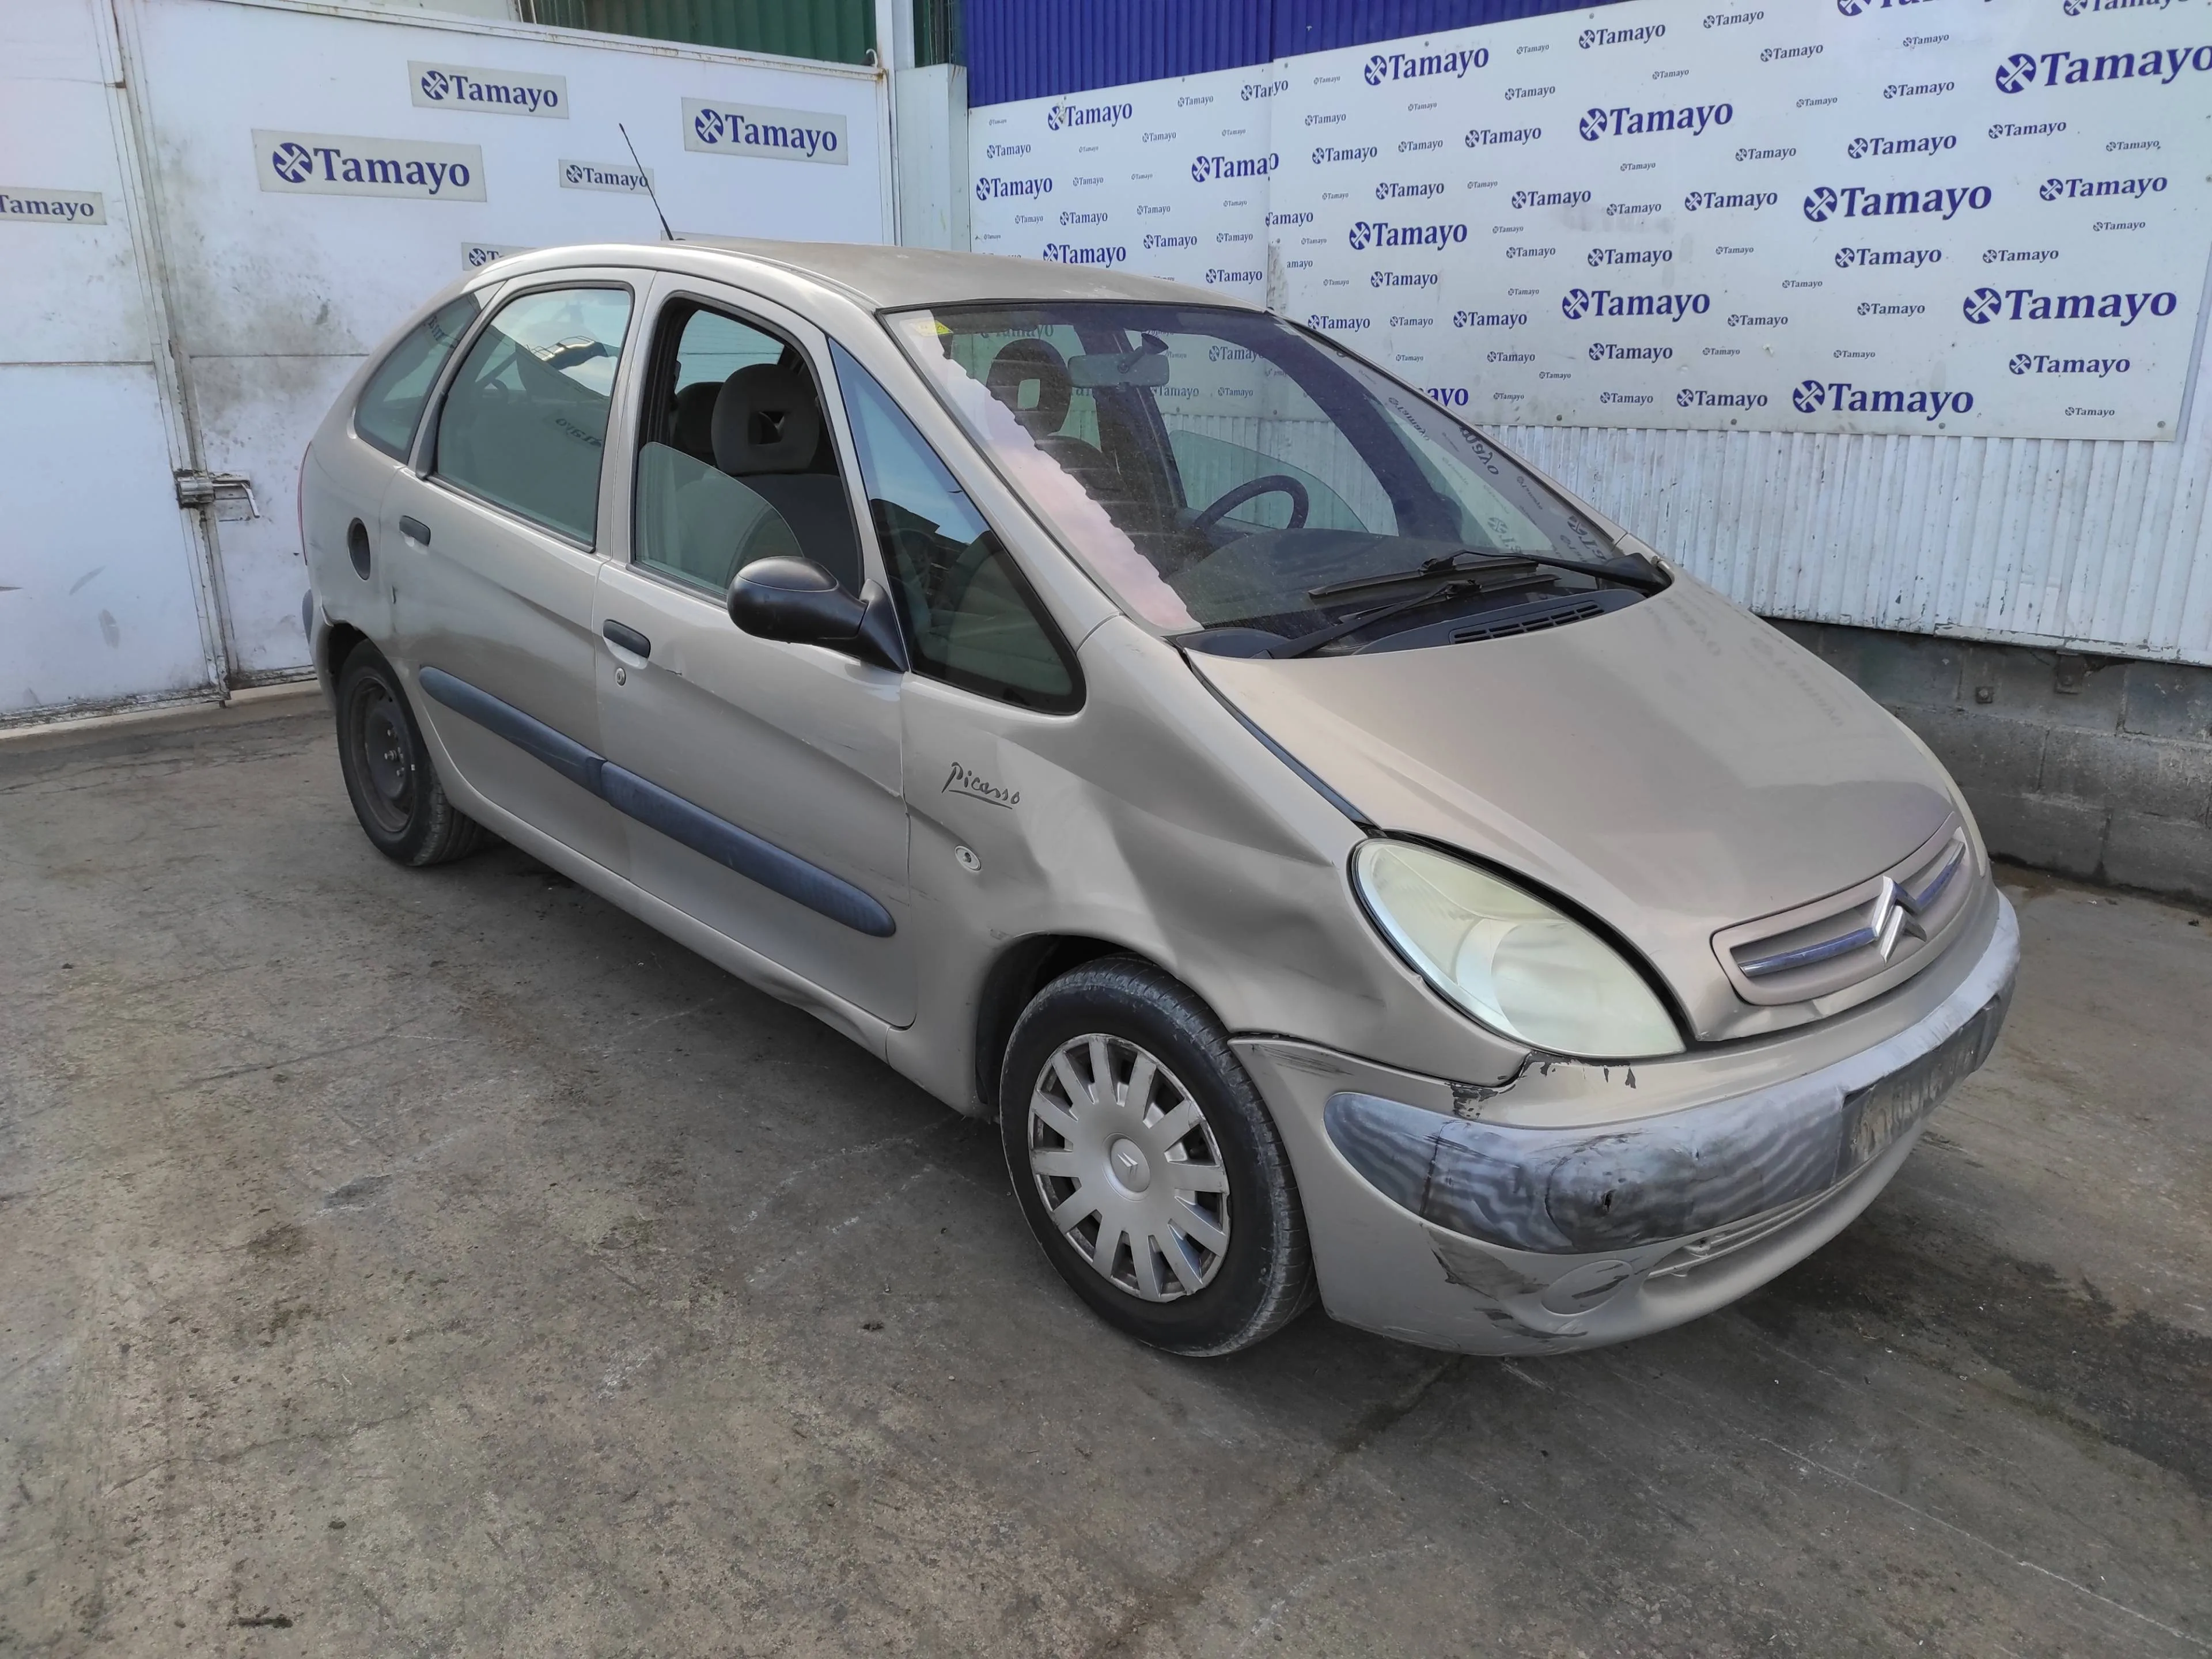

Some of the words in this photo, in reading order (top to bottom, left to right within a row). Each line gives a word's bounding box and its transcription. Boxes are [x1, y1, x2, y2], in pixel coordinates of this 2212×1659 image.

[1716, 12, 1764, 26] Tamayo
[1597, 25, 1665, 46] Tamayo
[1912, 35, 1949, 46] Tamayo
[1524, 45, 1549, 53] Tamayo
[1773, 45, 1823, 59] Tamayo
[1389, 47, 1488, 80] Tamayo
[2040, 46, 2212, 86] Tamayo
[1660, 70, 1689, 78] Tamayo
[449, 75, 558, 112] Tamayo
[1516, 86, 1555, 98] Tamayo
[1899, 82, 1954, 96] Tamayo
[1185, 96, 1213, 105] Tamayo
[1805, 97, 1837, 106] Tamayo
[1065, 104, 1132, 127] Tamayo
[1313, 114, 1346, 124] Tamayo
[1610, 104, 1733, 136] Tamayo
[725, 114, 837, 157] Tamayo
[2005, 122, 2066, 136] Tamayo
[1149, 132, 1176, 141] Tamayo
[1480, 128, 1541, 145] Tamayo
[995, 145, 1031, 157] Tamayo
[1407, 140, 1442, 151] Tamayo
[1870, 135, 1956, 156] Tamayo
[2117, 141, 2159, 151] Tamayo
[1325, 147, 1377, 162] Tamayo
[1748, 148, 1796, 160] Tamayo
[313, 148, 469, 195] Tamayo
[582, 167, 647, 191] Tamayo
[1079, 177, 1103, 185] Tamayo
[991, 178, 1052, 199] Tamayo
[1390, 183, 1444, 199] Tamayo
[2066, 177, 2167, 198] Tamayo
[1528, 191, 1590, 207] Tamayo
[1704, 192, 1777, 210] Tamayo
[1840, 186, 1991, 220] Tamayo
[1143, 206, 1170, 215] Tamayo
[1618, 204, 1661, 215] Tamayo
[1021, 215, 1043, 224] Tamayo
[1070, 213, 1108, 225] Tamayo
[2104, 222, 2145, 230] Tamayo
[1154, 235, 1197, 249] Tamayo
[1224, 233, 1253, 243] Tamayo
[1373, 223, 1467, 251] Tamayo
[1059, 245, 1126, 268] Tamayo
[1516, 248, 1555, 258] Tamayo
[1605, 249, 1672, 267] Tamayo
[1724, 247, 1753, 255] Tamayo
[1998, 250, 2058, 263] Tamayo
[1857, 249, 1941, 268] Tamayo
[1217, 270, 1262, 284] Tamayo
[1384, 272, 1437, 289] Tamayo
[1790, 281, 1823, 289] Tamayo
[1592, 290, 1710, 322] Tamayo
[1871, 304, 1925, 317] Tamayo
[2005, 290, 2176, 327] Tamayo
[1319, 316, 1370, 331] Tamayo
[1399, 317, 1433, 328] Tamayo
[1468, 312, 1527, 329] Tamayo
[1740, 315, 1788, 327] Tamayo
[1221, 346, 1264, 362] Tamay
[1497, 353, 1535, 363] Tamayo
[1606, 344, 1672, 363] Tamayo
[1842, 351, 1875, 359] Tamayo
[2034, 355, 2130, 378] Tamayo
[1545, 372, 1571, 380] Tamayo
[1159, 387, 1199, 399] Tamayo
[1225, 388, 1253, 398] Tamayo
[1499, 393, 1524, 402] Tamayo
[1611, 393, 1653, 406] Tamayo
[1695, 391, 1767, 411] Tamayo
[1828, 384, 1973, 421] Tamayo
[2075, 408, 2115, 418] Tamayo
[941, 762, 1020, 805] Picasso
